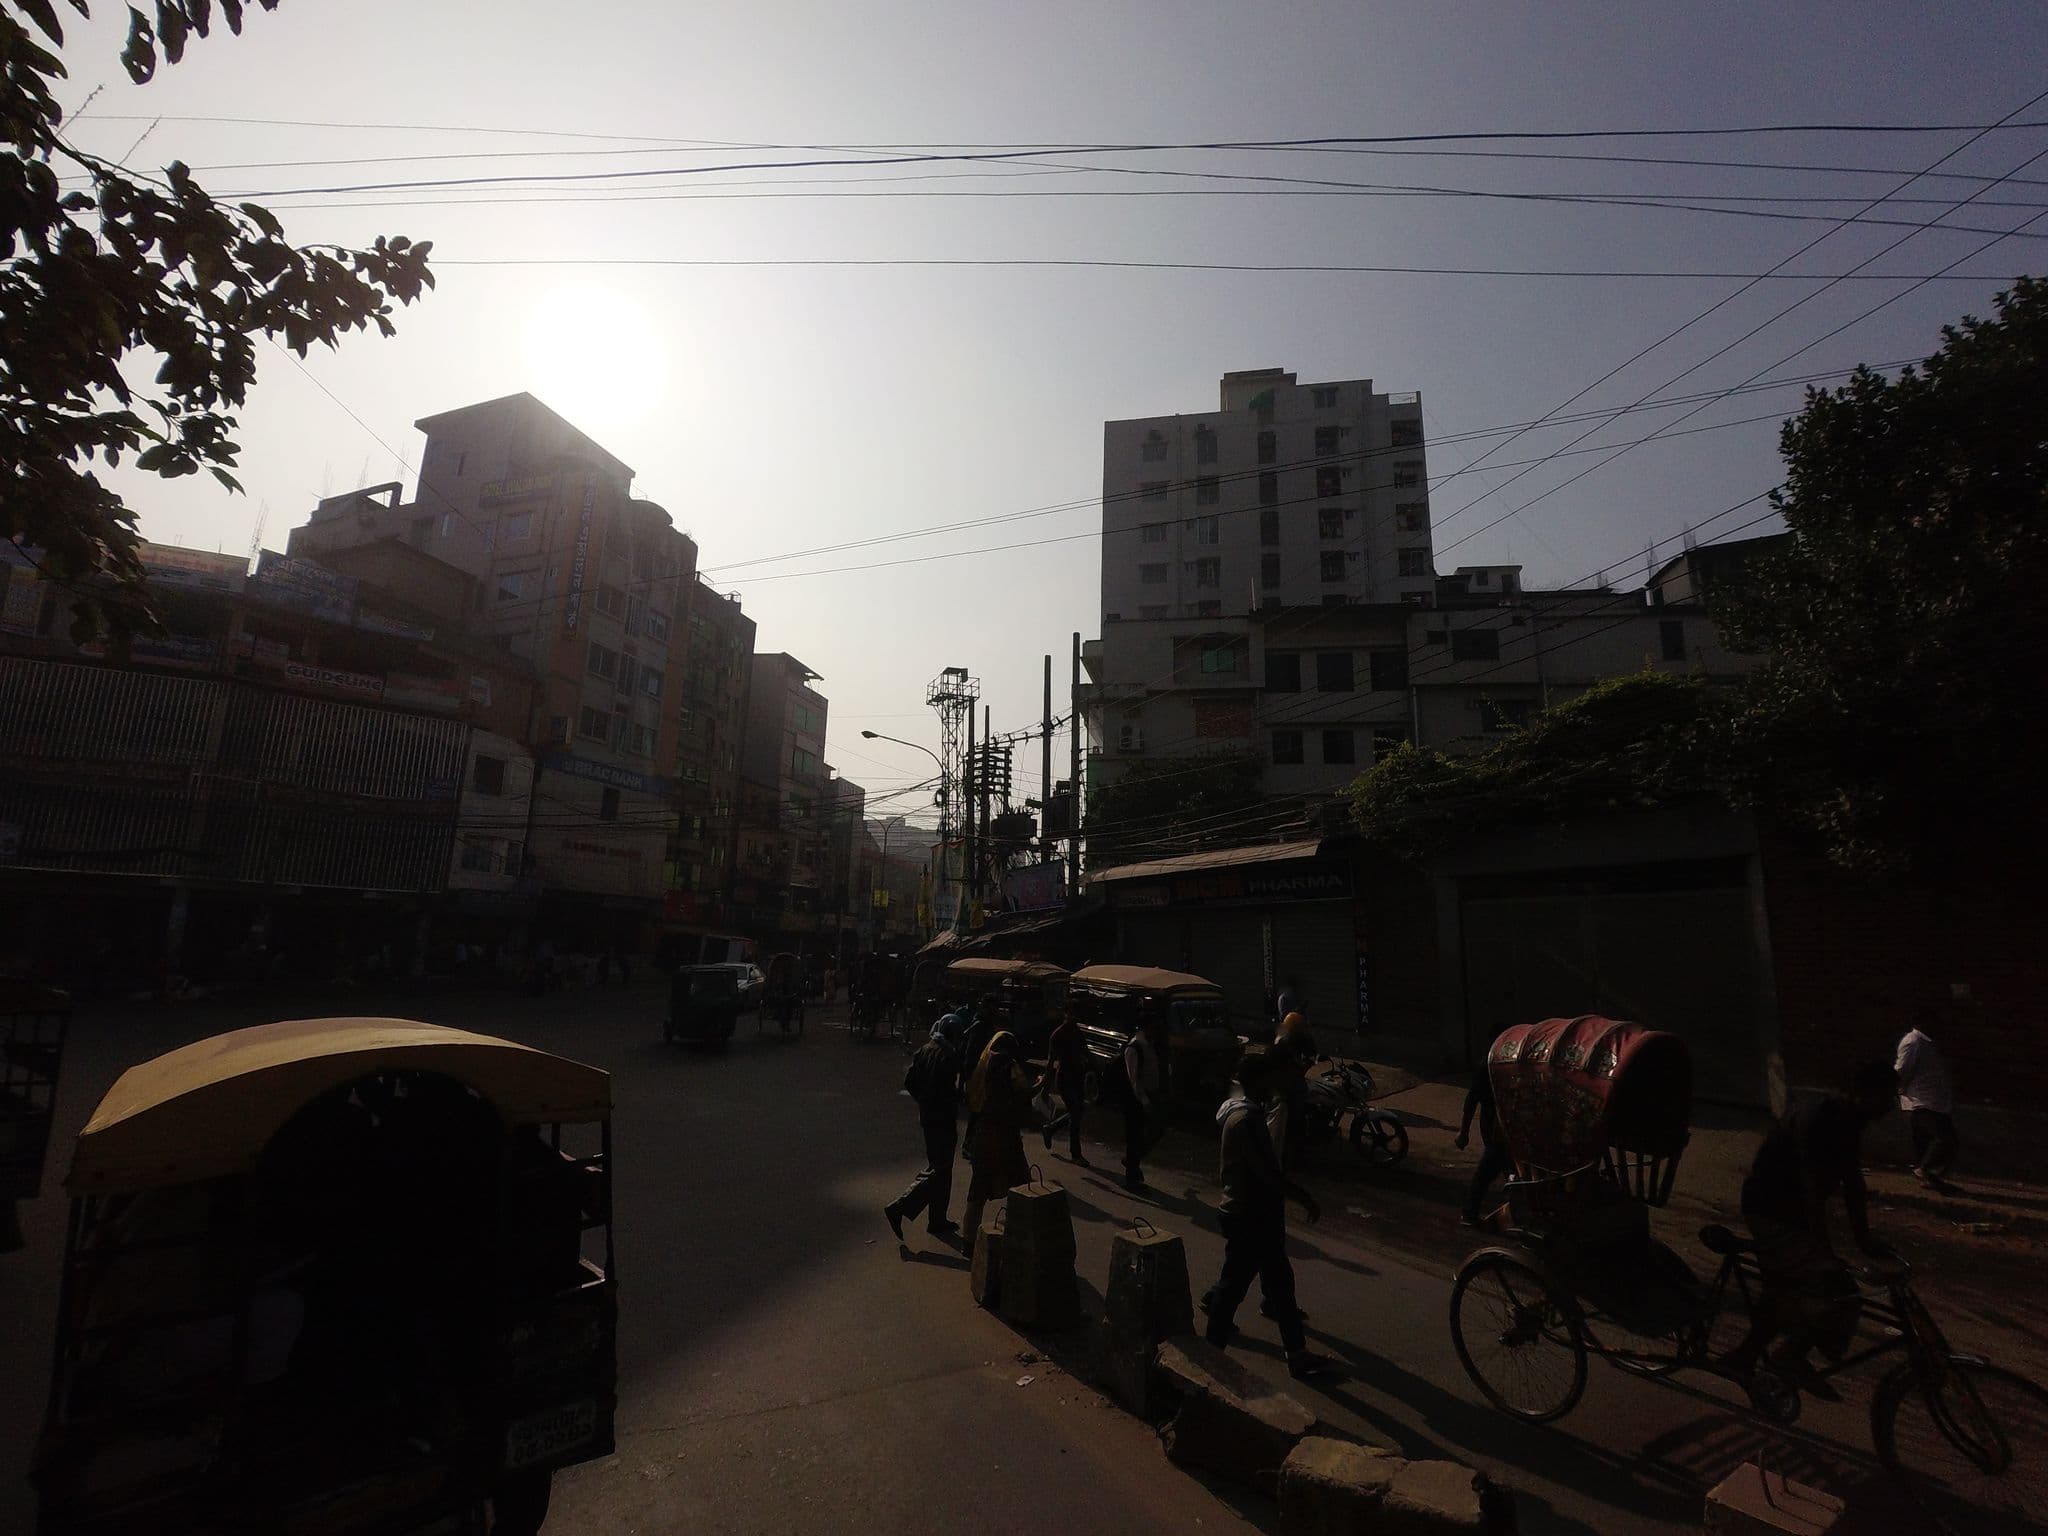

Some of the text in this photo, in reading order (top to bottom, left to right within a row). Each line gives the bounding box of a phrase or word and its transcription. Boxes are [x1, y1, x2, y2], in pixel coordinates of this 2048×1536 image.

[286, 663, 383, 692] GUIDELINE
[575, 760, 643, 789] BRAC BANK
[1248, 872, 1345, 894] PHARMA
[1358, 957, 1370, 1024] PHARMA
